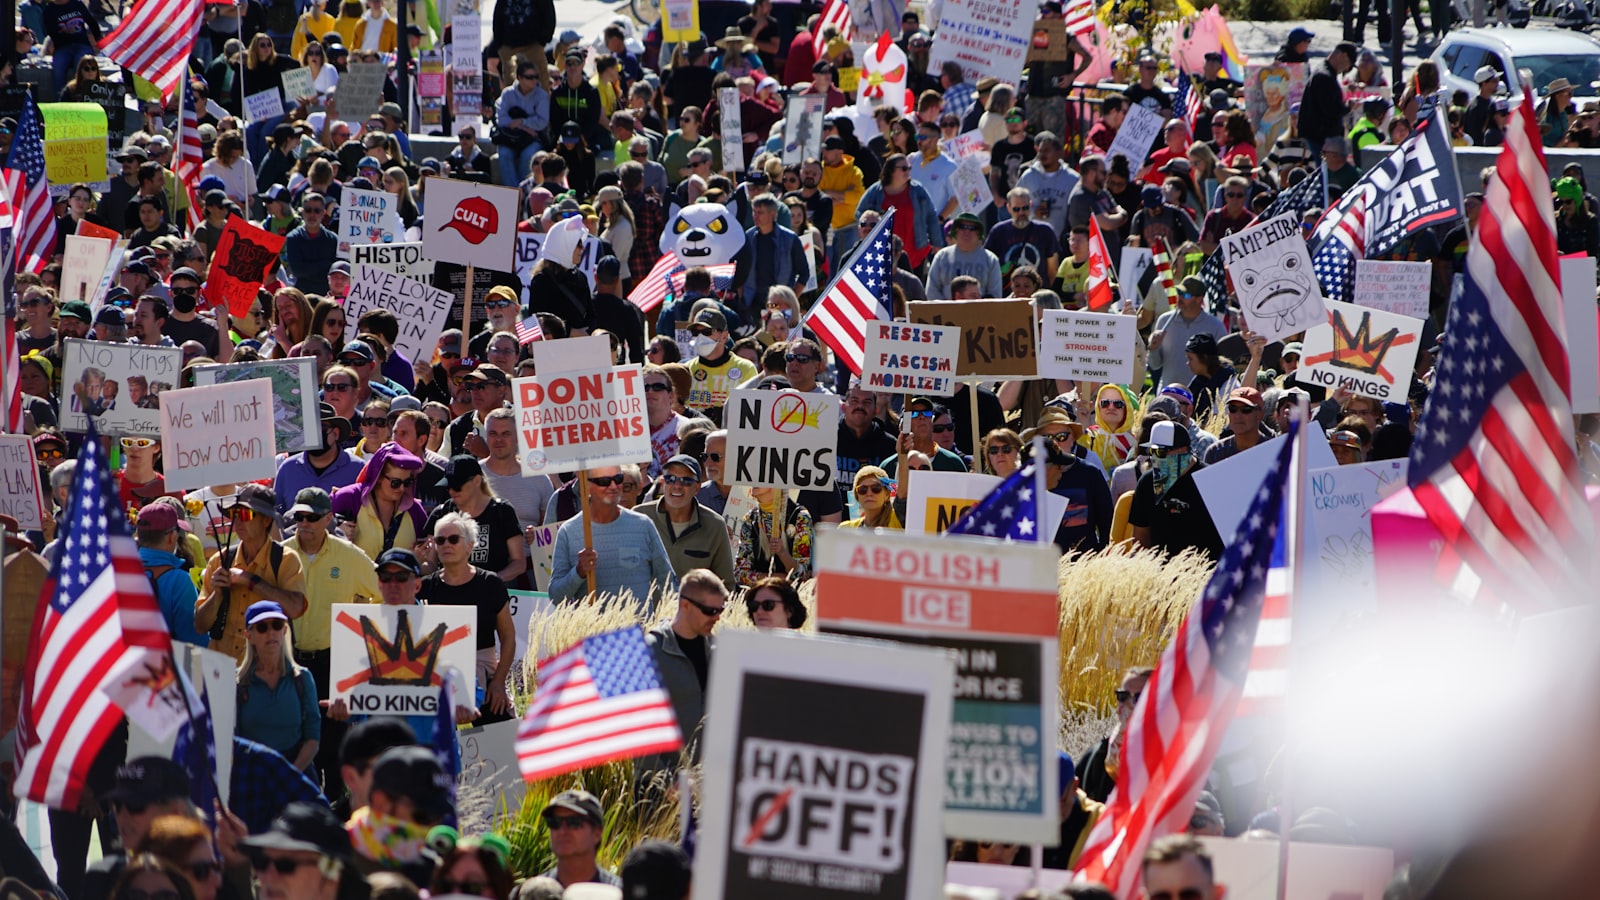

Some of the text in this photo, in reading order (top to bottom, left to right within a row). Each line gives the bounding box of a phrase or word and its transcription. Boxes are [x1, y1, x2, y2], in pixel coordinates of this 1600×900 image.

[456, 58, 477, 67] JAIL
[91, 83, 114, 97] Only
[1137, 108, 1154, 121] NO
[1126, 117, 1154, 137] KINGS
[954, 135, 971, 147] NO
[351, 192, 386, 209] DONALD
[348, 210, 384, 224] TRUMP
[454, 207, 488, 229] CULT
[350, 225, 361, 236] IS
[355, 246, 432, 264] HISTO
[395, 265, 406, 273] is
[362, 265, 397, 292] WE
[400, 278, 447, 311] LOVE
[350, 283, 436, 325] AMERICA!
[879, 325, 943, 344] RESIST
[1065, 343, 1108, 352] STRONGER
[79, 343, 174, 375] No Kings
[880, 353, 951, 372] FASCISM
[519, 370, 638, 408] DON'T
[869, 372, 949, 392] MOBILIZE!
[1312, 366, 1391, 398] NO KINGS
[166, 395, 261, 429] We will not
[521, 397, 641, 427] ABANDON OUR
[127, 419, 160, 432] Joffre
[523, 416, 644, 449] VETERANS
[0, 444, 28, 463] THE
[176, 435, 262, 469] bow down
[736, 445, 833, 486] KINGS
[4, 468, 34, 494] LAW
[1312, 472, 1336, 496] NO
[2, 499, 34, 522] NGS
[1315, 492, 1366, 510] CROWNS!
[535, 527, 552, 547] NO
[849, 544, 1000, 584] ABOLISH
[906, 592, 963, 622] ICE
[972, 650, 997, 672] IN
[983, 677, 1023, 699] ICE
[350, 694, 438, 712] NO KING
[1005, 724, 1038, 746] TO
[751, 747, 899, 797] HANDS
[744, 787, 896, 858] OFF!
[818, 864, 885, 893] SECURITY
